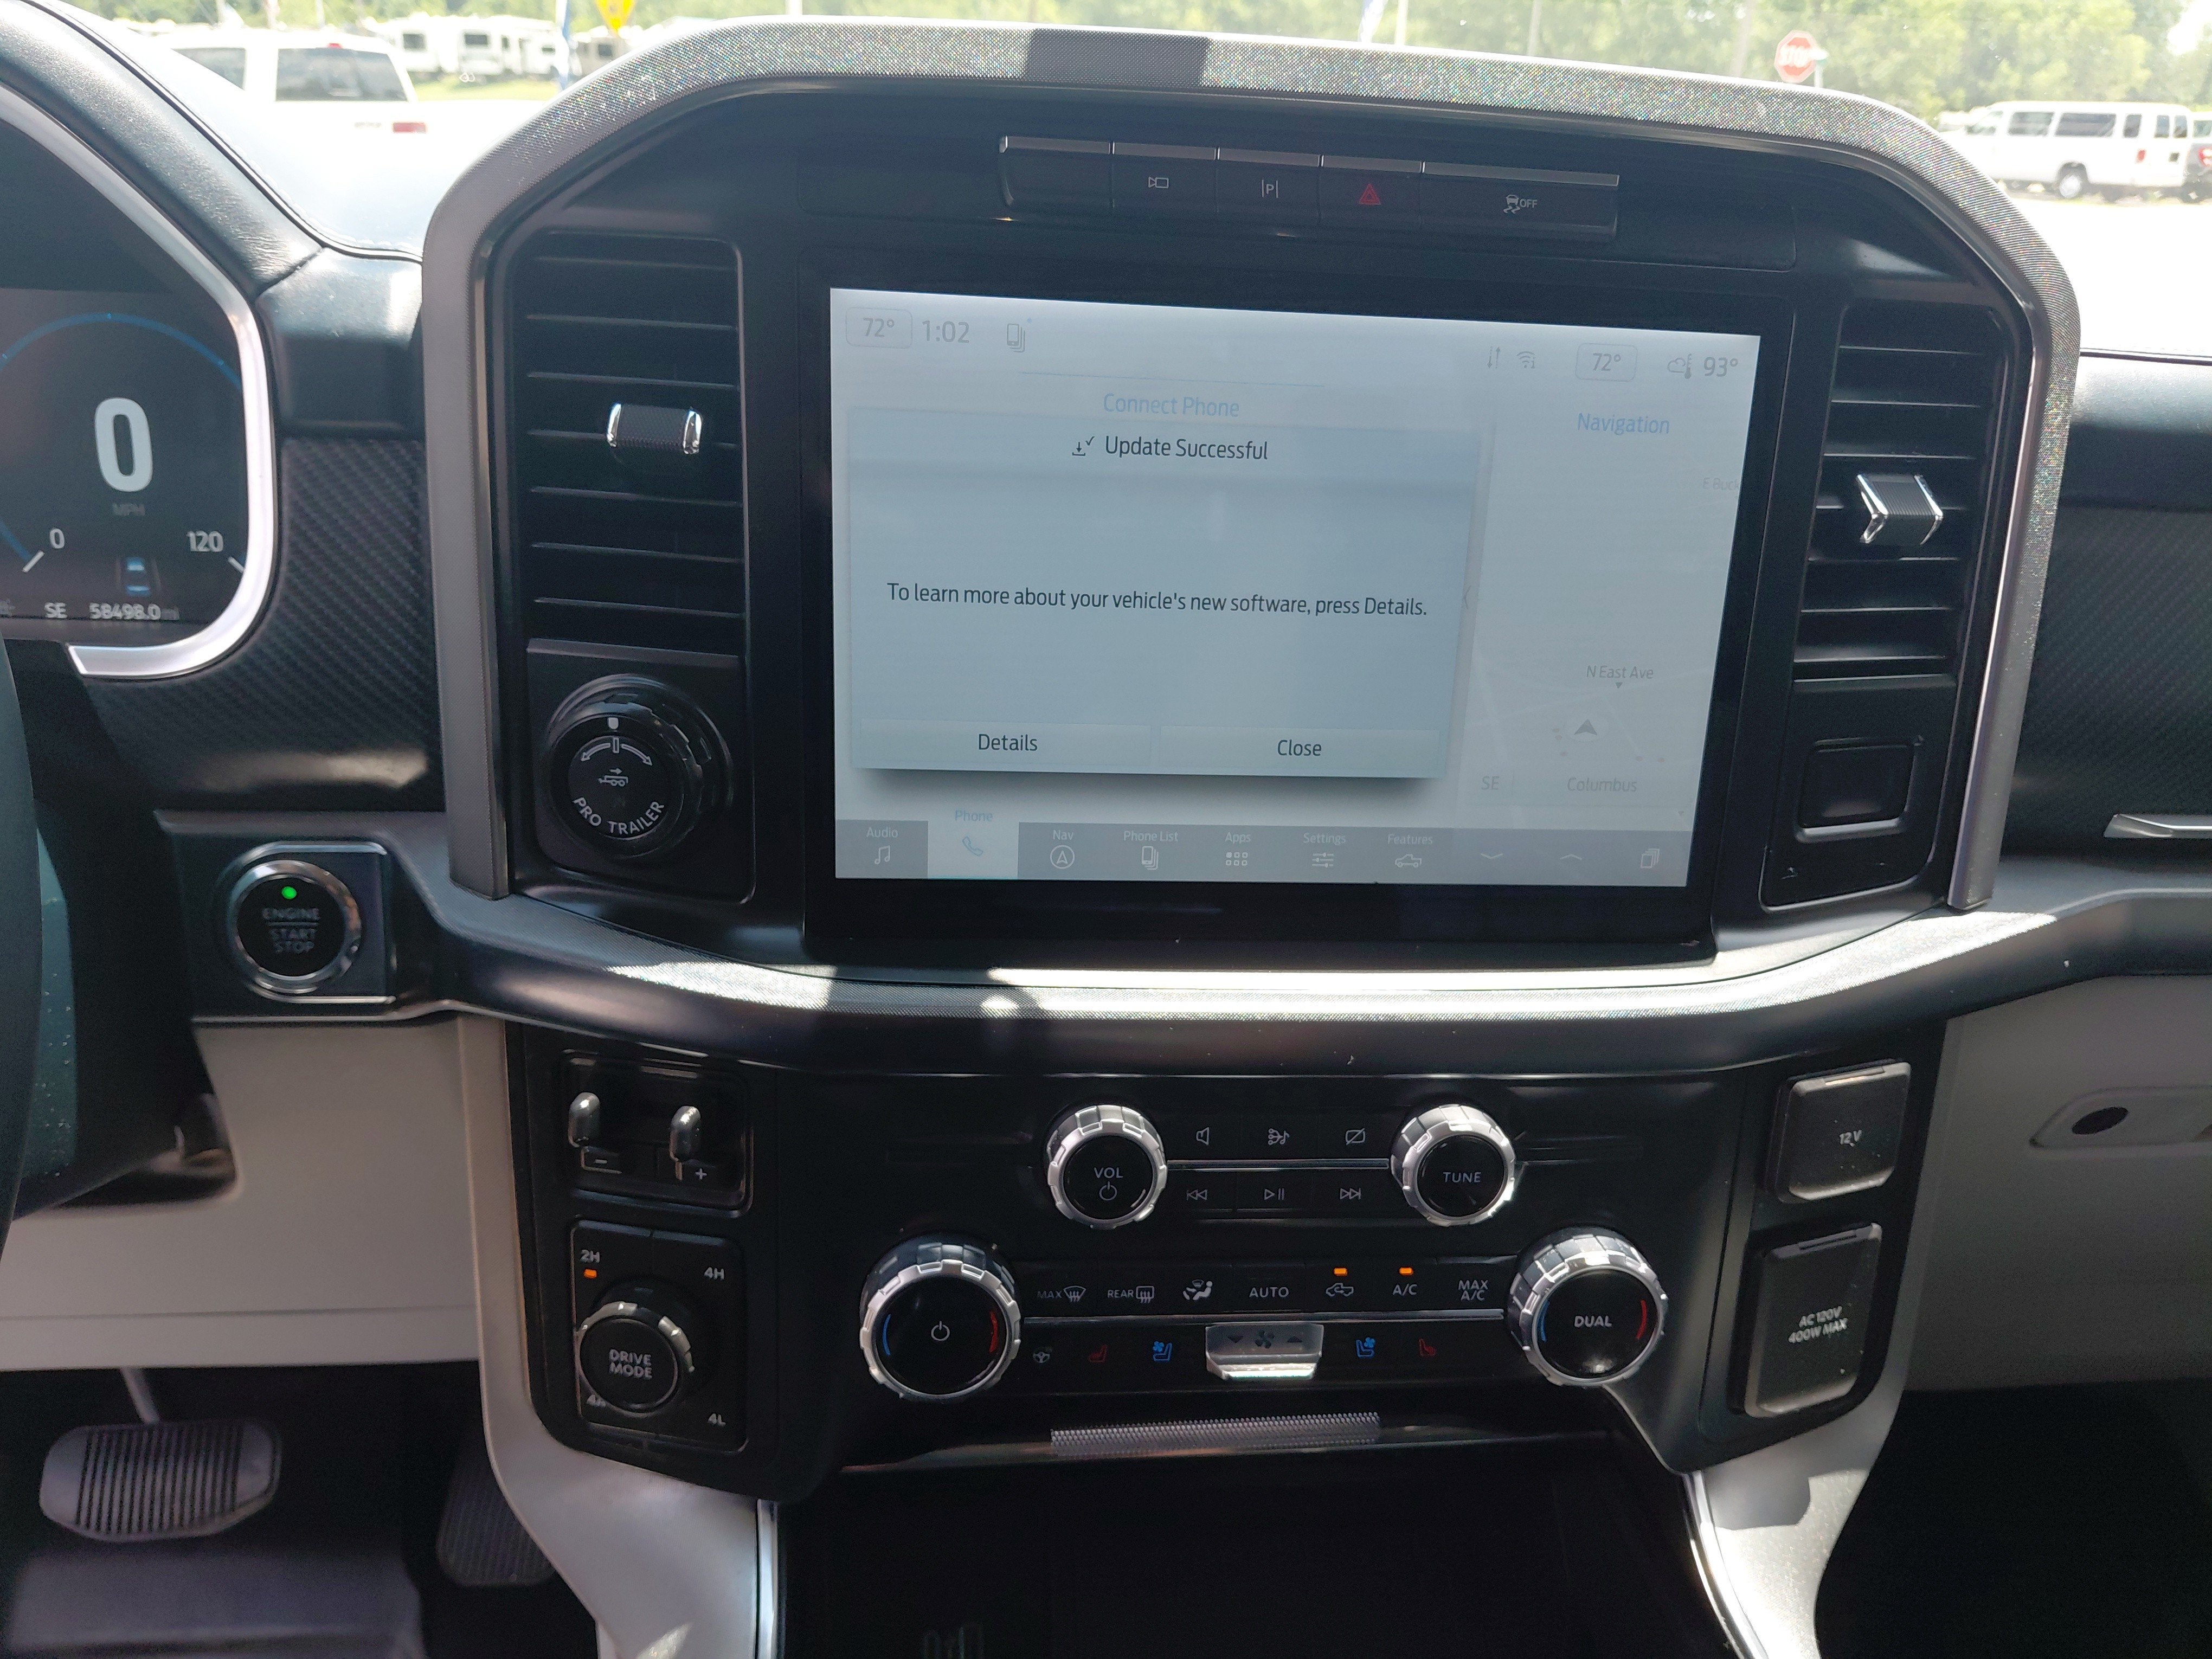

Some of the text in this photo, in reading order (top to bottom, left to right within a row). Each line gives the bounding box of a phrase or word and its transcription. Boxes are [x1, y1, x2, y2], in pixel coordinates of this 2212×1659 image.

[1520, 198, 1537, 209] OFF
[922, 320, 970, 344] 1:02
[1103, 393, 1240, 417] Connect Phone
[1577, 413, 1670, 436] Navigation
[94, 397, 153, 492] 0
[1105, 436, 1268, 460] Update Successful
[49, 528, 65, 549] 0
[186, 530, 224, 552] 120
[887, 582, 1427, 616] To learn more about your vehicle's new software, press Details.
[44, 602, 68, 619] SE
[1586, 665, 1654, 679] N East Ave
[978, 734, 1038, 751] Details
[1277, 740, 1322, 756] Close
[1481, 775, 1500, 791] SE
[1567, 777, 1637, 793] Columbus
[572, 797, 665, 835] PRO TRAILER
[954, 809, 993, 822] Phone
[866, 826, 899, 838] Audio
[1052, 829, 1074, 841] Nav
[1123, 830, 1179, 843] Phone List
[1225, 832, 1251, 844] Apps
[1303, 832, 1346, 846] Settings
[1387, 833, 1433, 845] Features
[1839, 1130, 1862, 1146] 12V
[1094, 1167, 1124, 1179] VOL
[1443, 1172, 1482, 1183] TUNE
[580, 1250, 600, 1263] 2H
[704, 1267, 725, 1280] 4H
[1392, 1284, 1418, 1296] A/C
[1458, 1279, 1489, 1290] MAX
[1037, 1290, 1062, 1298] MAX
[1107, 1289, 1134, 1298] REAR
[1249, 1287, 1289, 1298] AUTO
[1461, 1290, 1485, 1301] A/C
[1574, 1315, 1612, 1328] DUAL
[1799, 1306, 1842, 1328] AC 120V
[1788, 1317, 1848, 1343] 400W MAX
[609, 1349, 652, 1366] DRIVE
[609, 1362, 652, 1379] MODE
[708, 1413, 726, 1427] 4L
